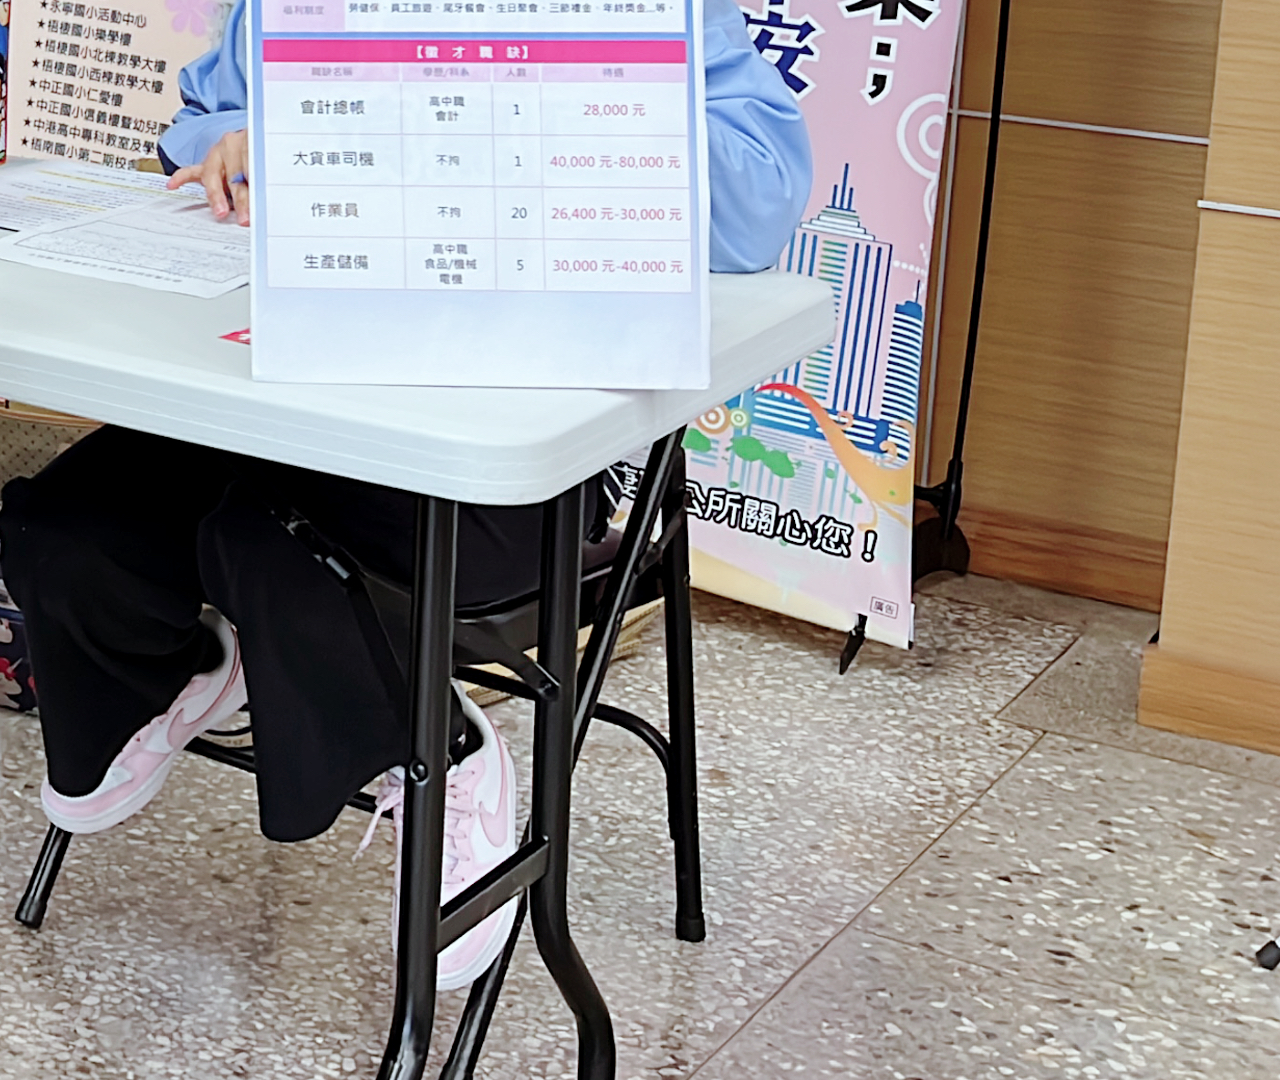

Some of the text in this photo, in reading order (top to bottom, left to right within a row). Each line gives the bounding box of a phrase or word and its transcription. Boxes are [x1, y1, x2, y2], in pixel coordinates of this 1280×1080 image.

[50, 0, 147, 29] 永寧國小活動中心
[45, 39, 167, 75] 梧棲國小北棟教學大樓
[42, 59, 164, 95] 梧棲國小西棟教學大樓
[39, 78, 124, 108] 中正國小仁愛樓
[429, 96, 465, 107] 高中職
[300, 100, 646, 117] 會計總帳 1 28,000 元
[435, 111, 459, 122] 會計
[293, 151, 375, 167] 大貨車司機
[435, 154, 460, 167] 不拘
[514, 156, 522, 167] 1
[550, 156, 595, 170] 40,000
[668, 156, 681, 170] 元
[311, 203, 359, 218] 作業員
[437, 206, 461, 218] 不拘
[511, 208, 527, 219] 20
[551, 208, 597, 221] 26,400
[669, 208, 682, 221] 元
[433, 244, 468, 255] 高中職
[304, 254, 369, 270] 生產儲備
[425, 258, 478, 270] 食品/機械
[516, 259, 524, 270] 5
[553, 259, 598, 273] 30,000
[670, 260, 683, 274] 元
[439, 273, 463, 285] 電機
[874, 600, 894, 614] 廣告
